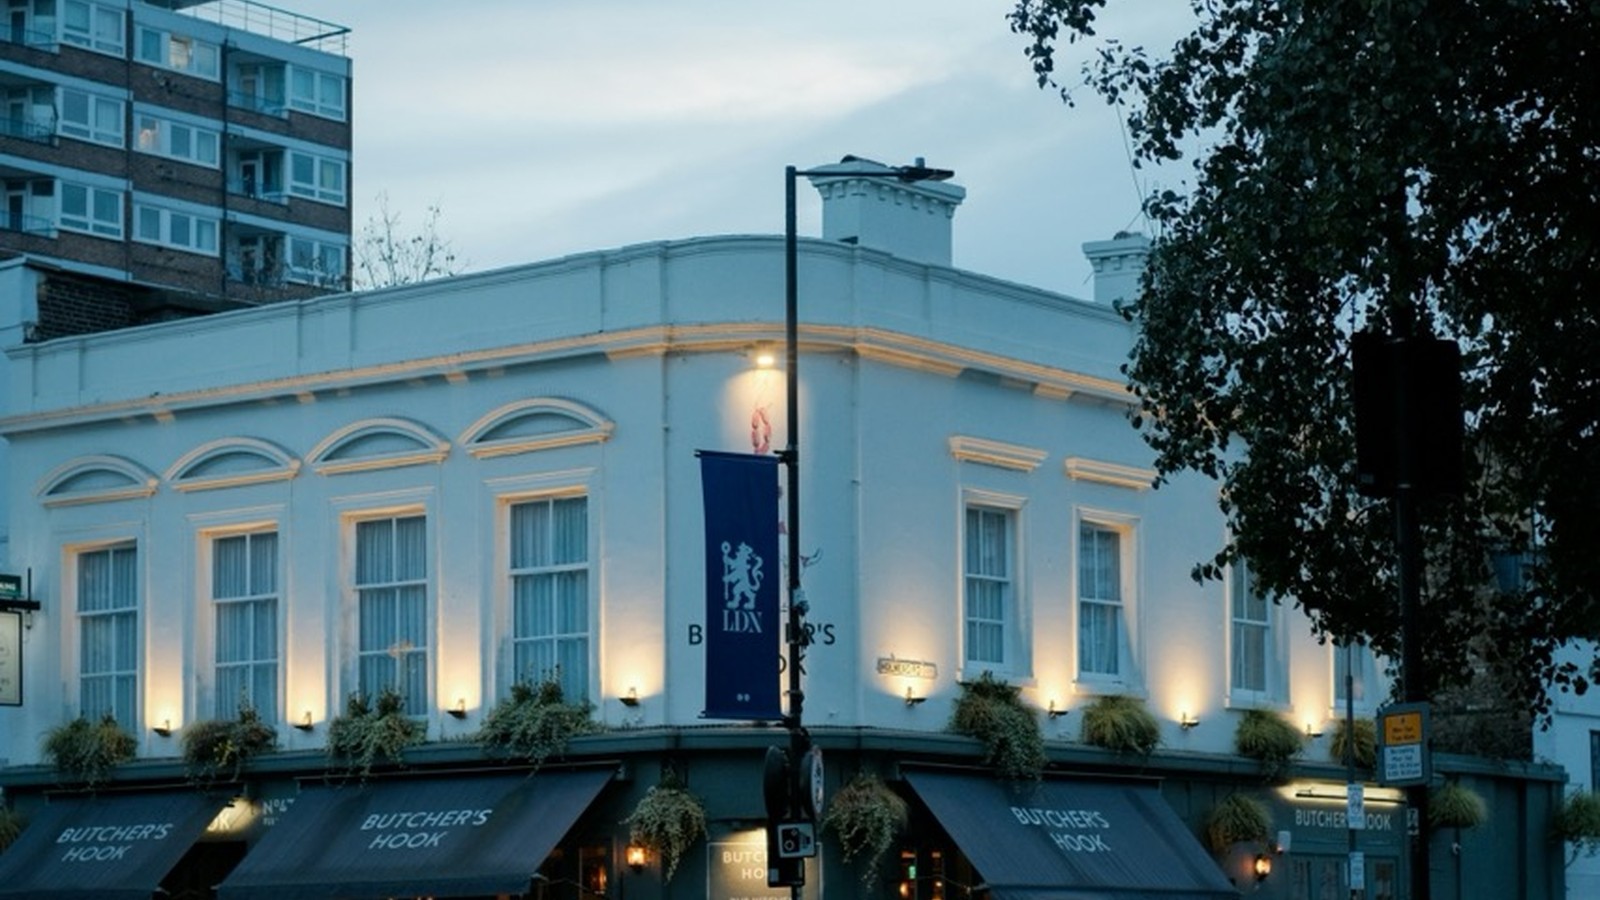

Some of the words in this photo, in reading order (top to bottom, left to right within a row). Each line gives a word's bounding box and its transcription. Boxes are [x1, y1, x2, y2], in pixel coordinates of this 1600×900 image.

[723, 609, 762, 633] LDN
[360, 809, 493, 830] BUTCHER'S
[1010, 806, 1110, 829] BUTCHER'S
[1294, 808, 1347, 828] BUTCHER
[1365, 812, 1392, 831] OOK
[57, 823, 174, 843] BUTCHER'S
[368, 831, 448, 849] HOOK
[1050, 832, 1111, 852] HOOK
[61, 845, 132, 862] HOOK
